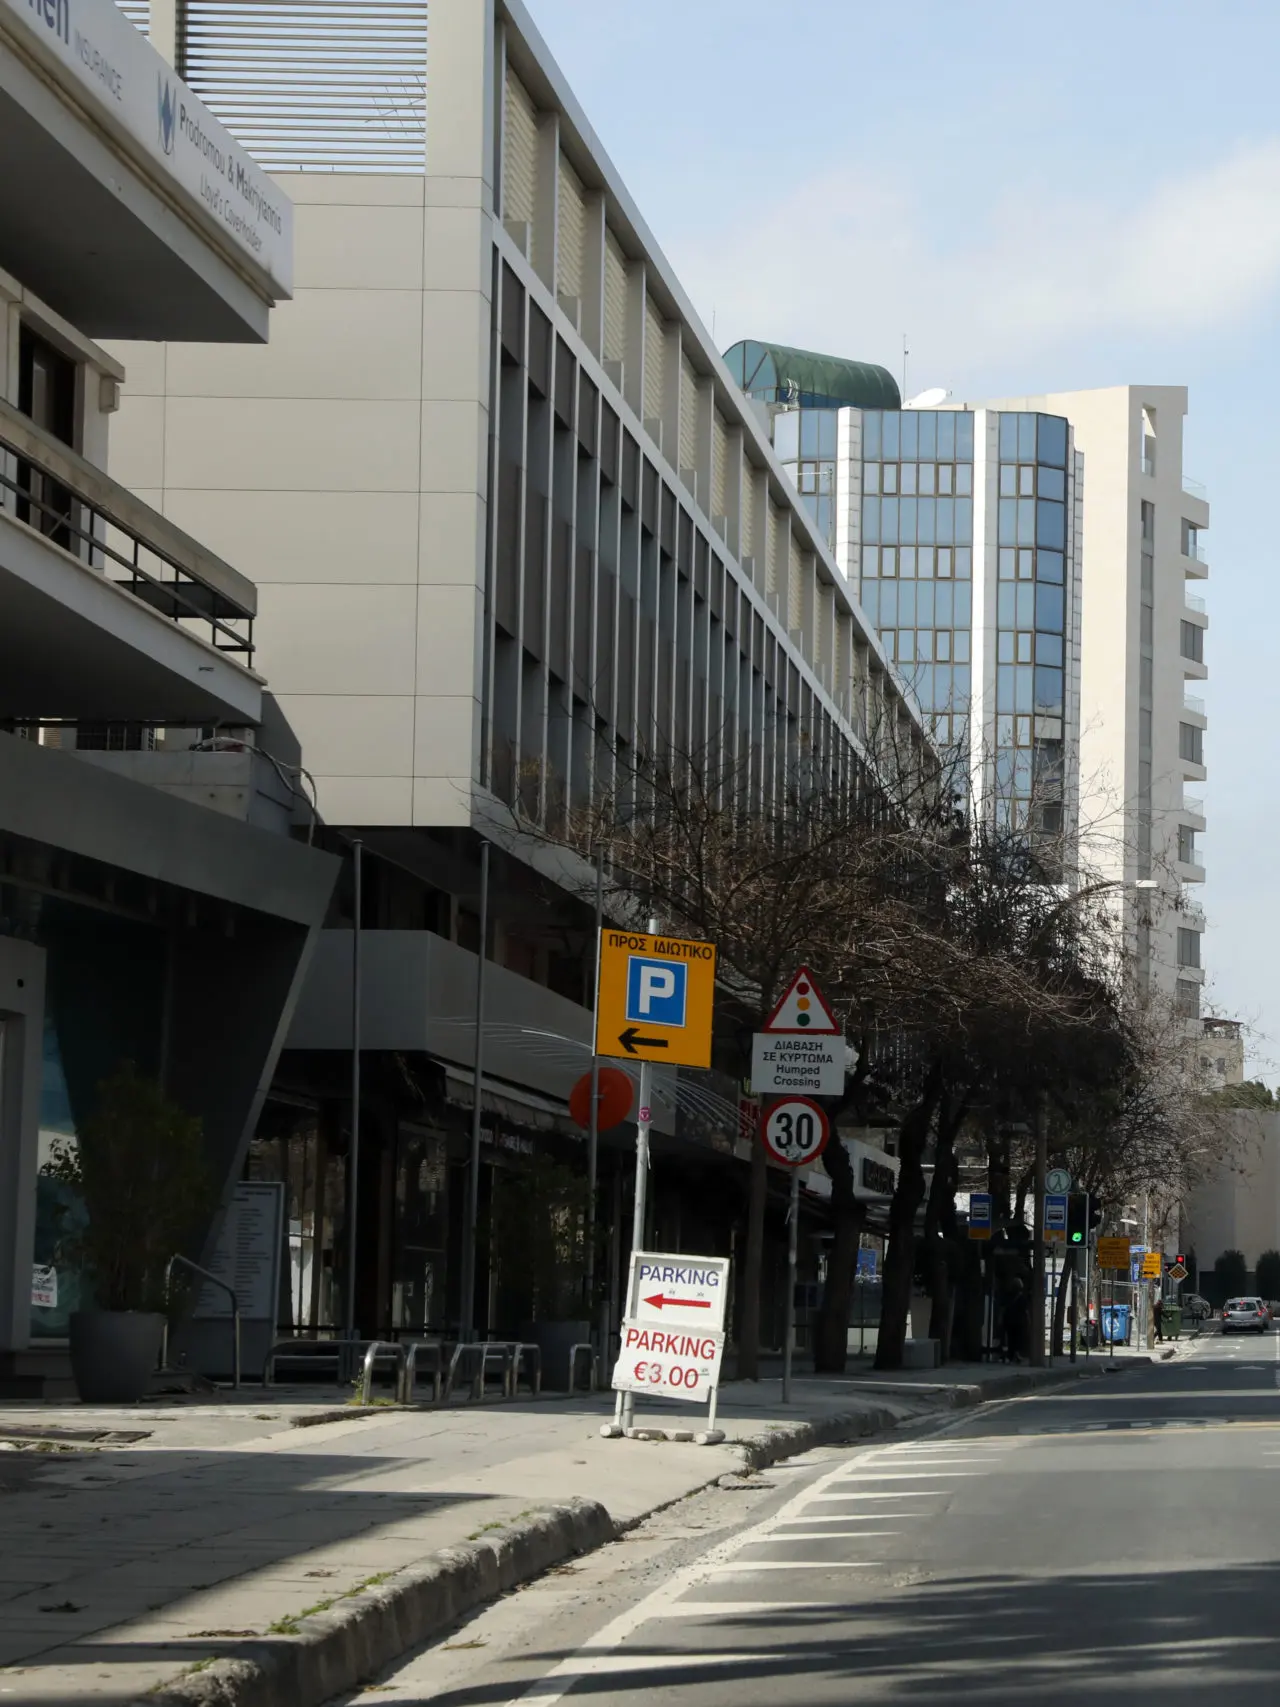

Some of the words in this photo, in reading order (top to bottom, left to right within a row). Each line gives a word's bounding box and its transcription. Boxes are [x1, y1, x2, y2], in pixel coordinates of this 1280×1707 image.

[75, 31, 123, 102] INSURANCE
[180, 103, 226, 176] Prodromou
[227, 154, 235, 183] &
[608, 933, 648, 952] ΠΡΟΣ
[653, 940, 713, 961] ΙΔΙΩΤΙΚΟ
[638, 965, 676, 1014] P
[763, 1051, 778, 1062] ΣΕ
[780, 1052, 834, 1065] ΚΥΡΤΩΜΑ
[774, 1040, 824, 1052] ΔΙΑΒΑΣΗ
[773, 1075, 822, 1089] Crossing
[776, 1064, 821, 1077] Humped
[775, 1112, 815, 1150] 30
[639, 1265, 720, 1287] PARKING
[625, 1328, 716, 1361] PARKING
[634, 1361, 700, 1389] €3.00
